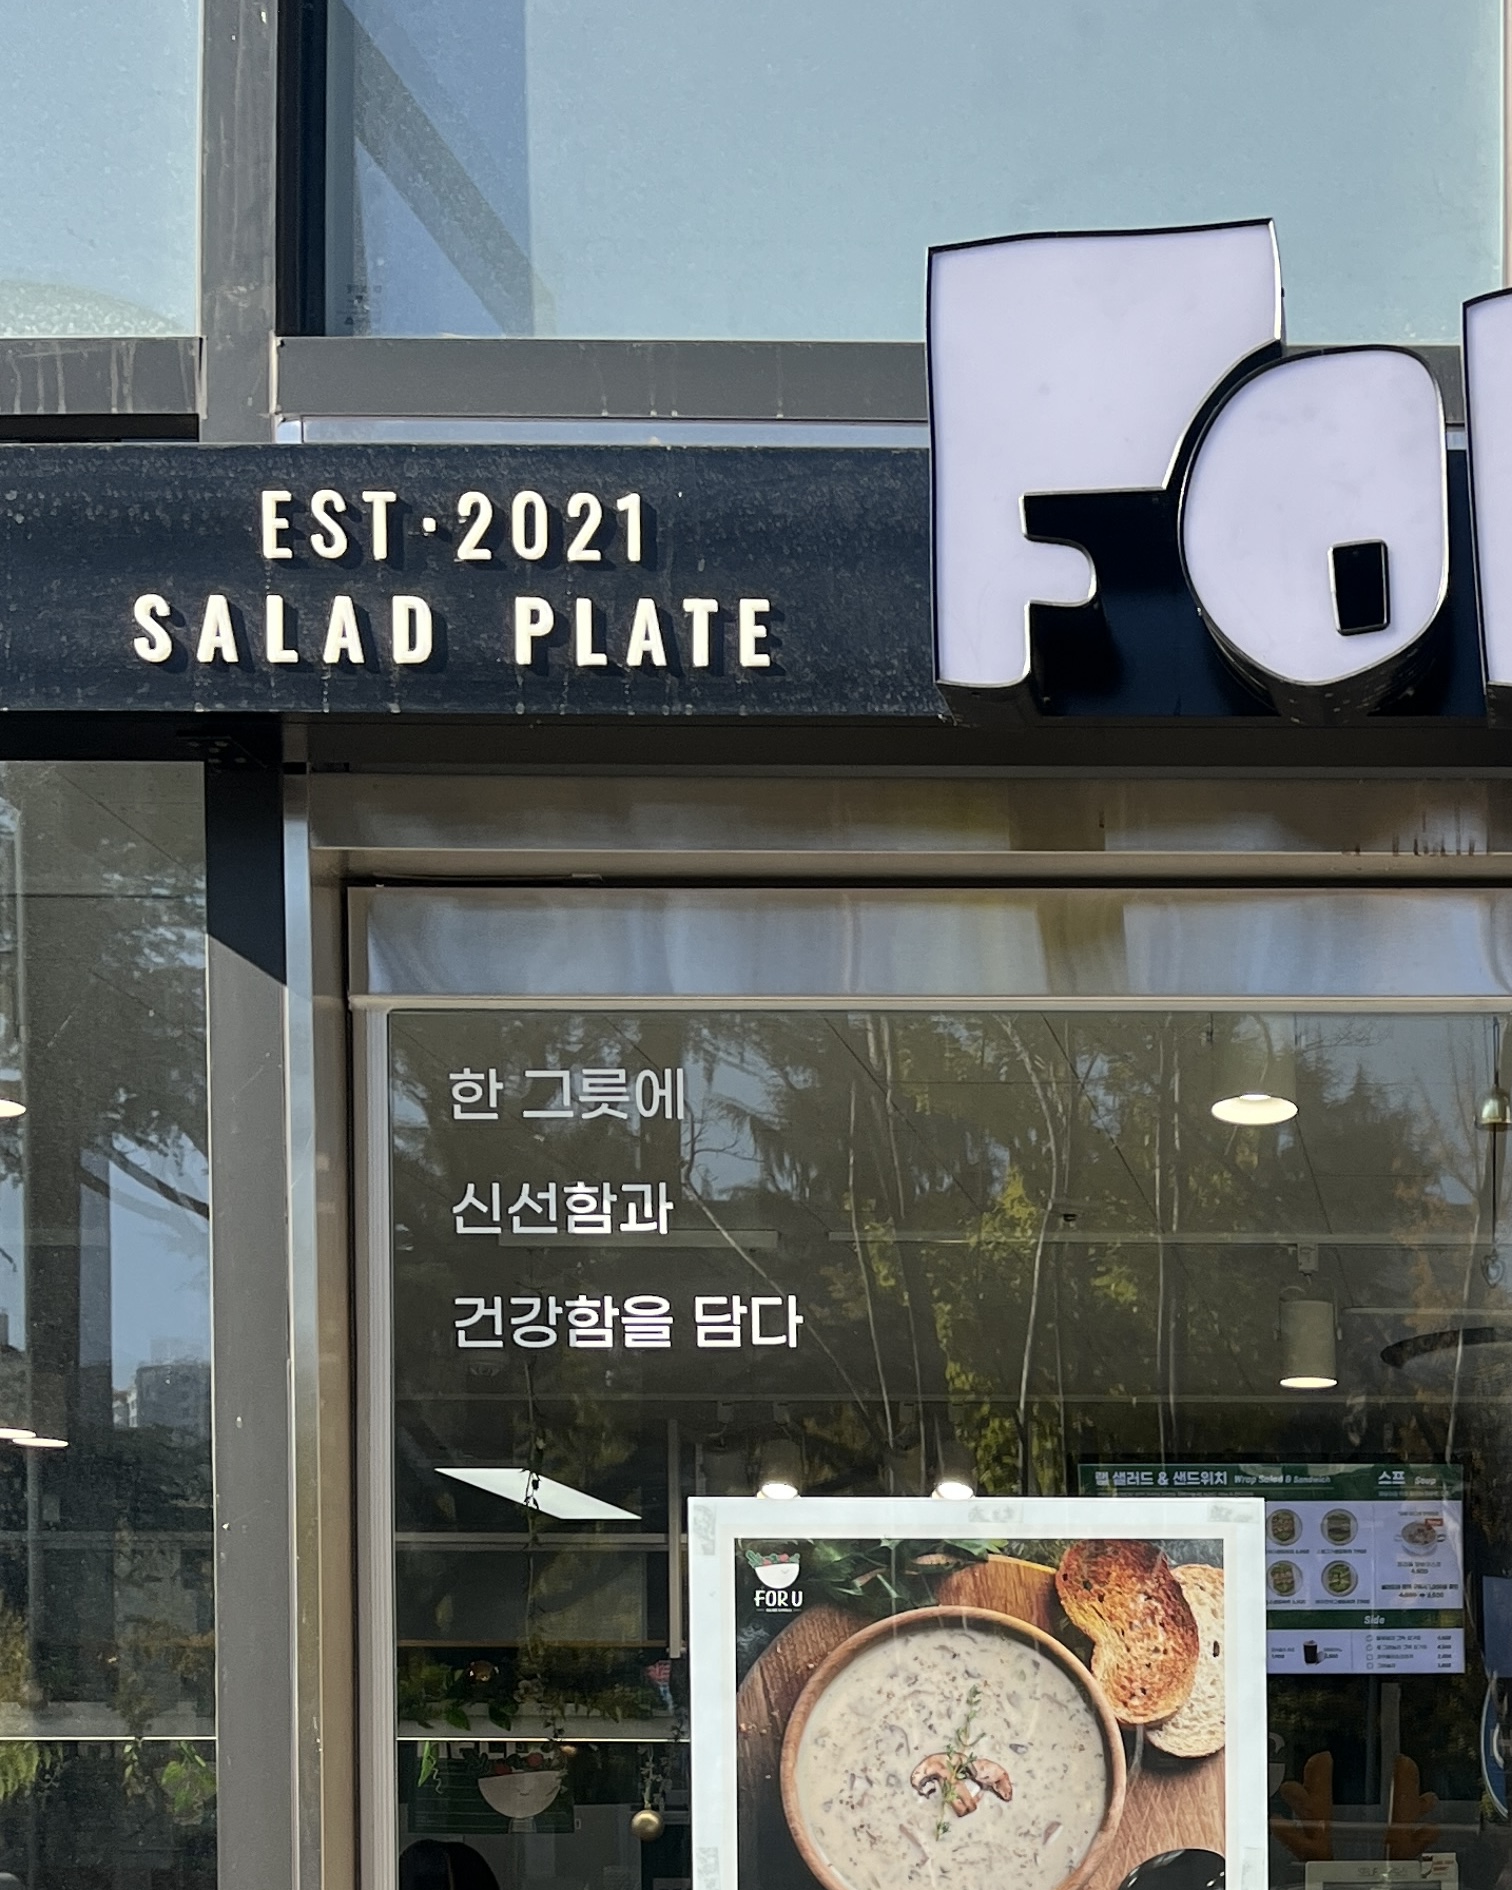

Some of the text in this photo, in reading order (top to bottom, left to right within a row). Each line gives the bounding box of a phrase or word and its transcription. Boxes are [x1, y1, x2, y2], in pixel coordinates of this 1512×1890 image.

[132, 593, 774, 668] SALAD PLATE
[448, 1067, 685, 1120] 한 그릇에
[451, 1181, 674, 1235] 신선함과
[454, 1294, 804, 1349] 건강함을 담다
[1157, 1471, 1170, 1486] &
[1172, 1471, 1228, 1486] 샌드위치
[1363, 1614, 1386, 1626] Side
